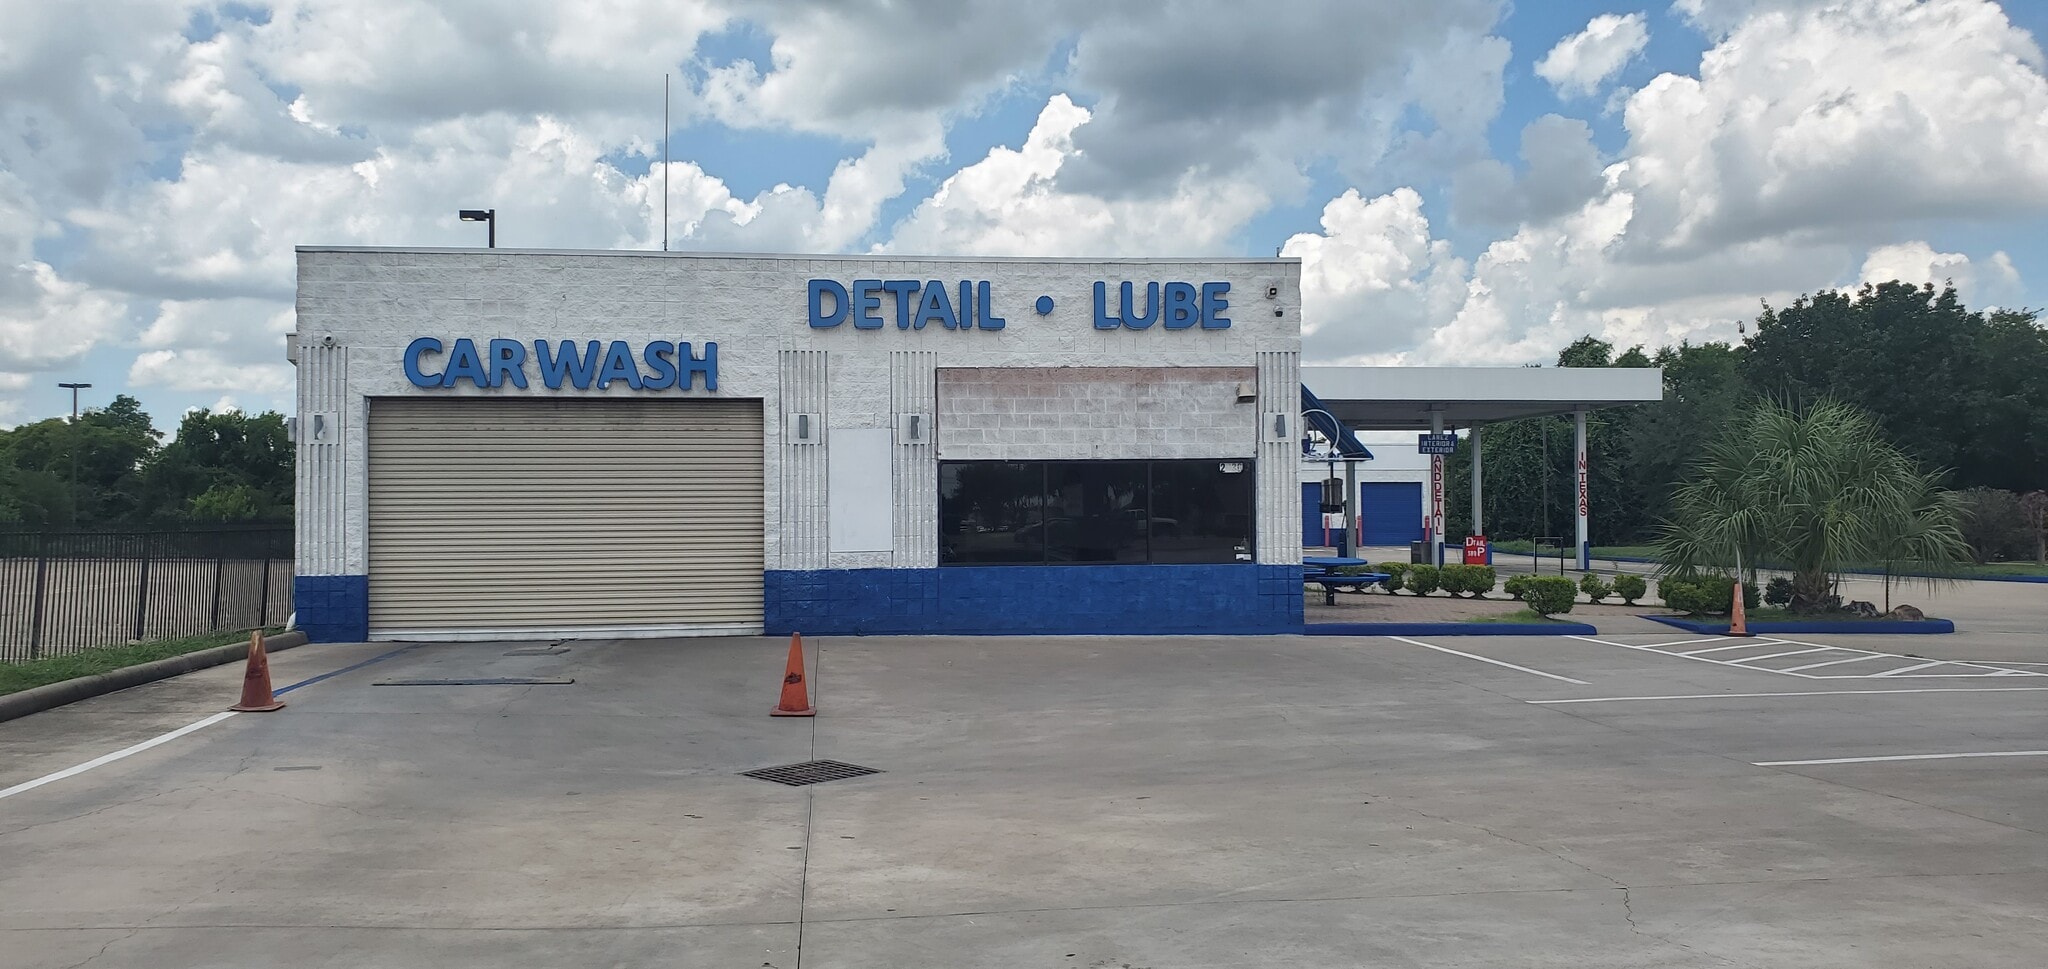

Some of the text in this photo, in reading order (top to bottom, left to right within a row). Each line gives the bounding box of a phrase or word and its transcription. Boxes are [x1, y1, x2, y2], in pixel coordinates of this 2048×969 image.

[808, 279, 1232, 330] DETAIL LUBE
[403, 337, 718, 391] CAR WASH
[1579, 472, 1587, 516] TEXAS
